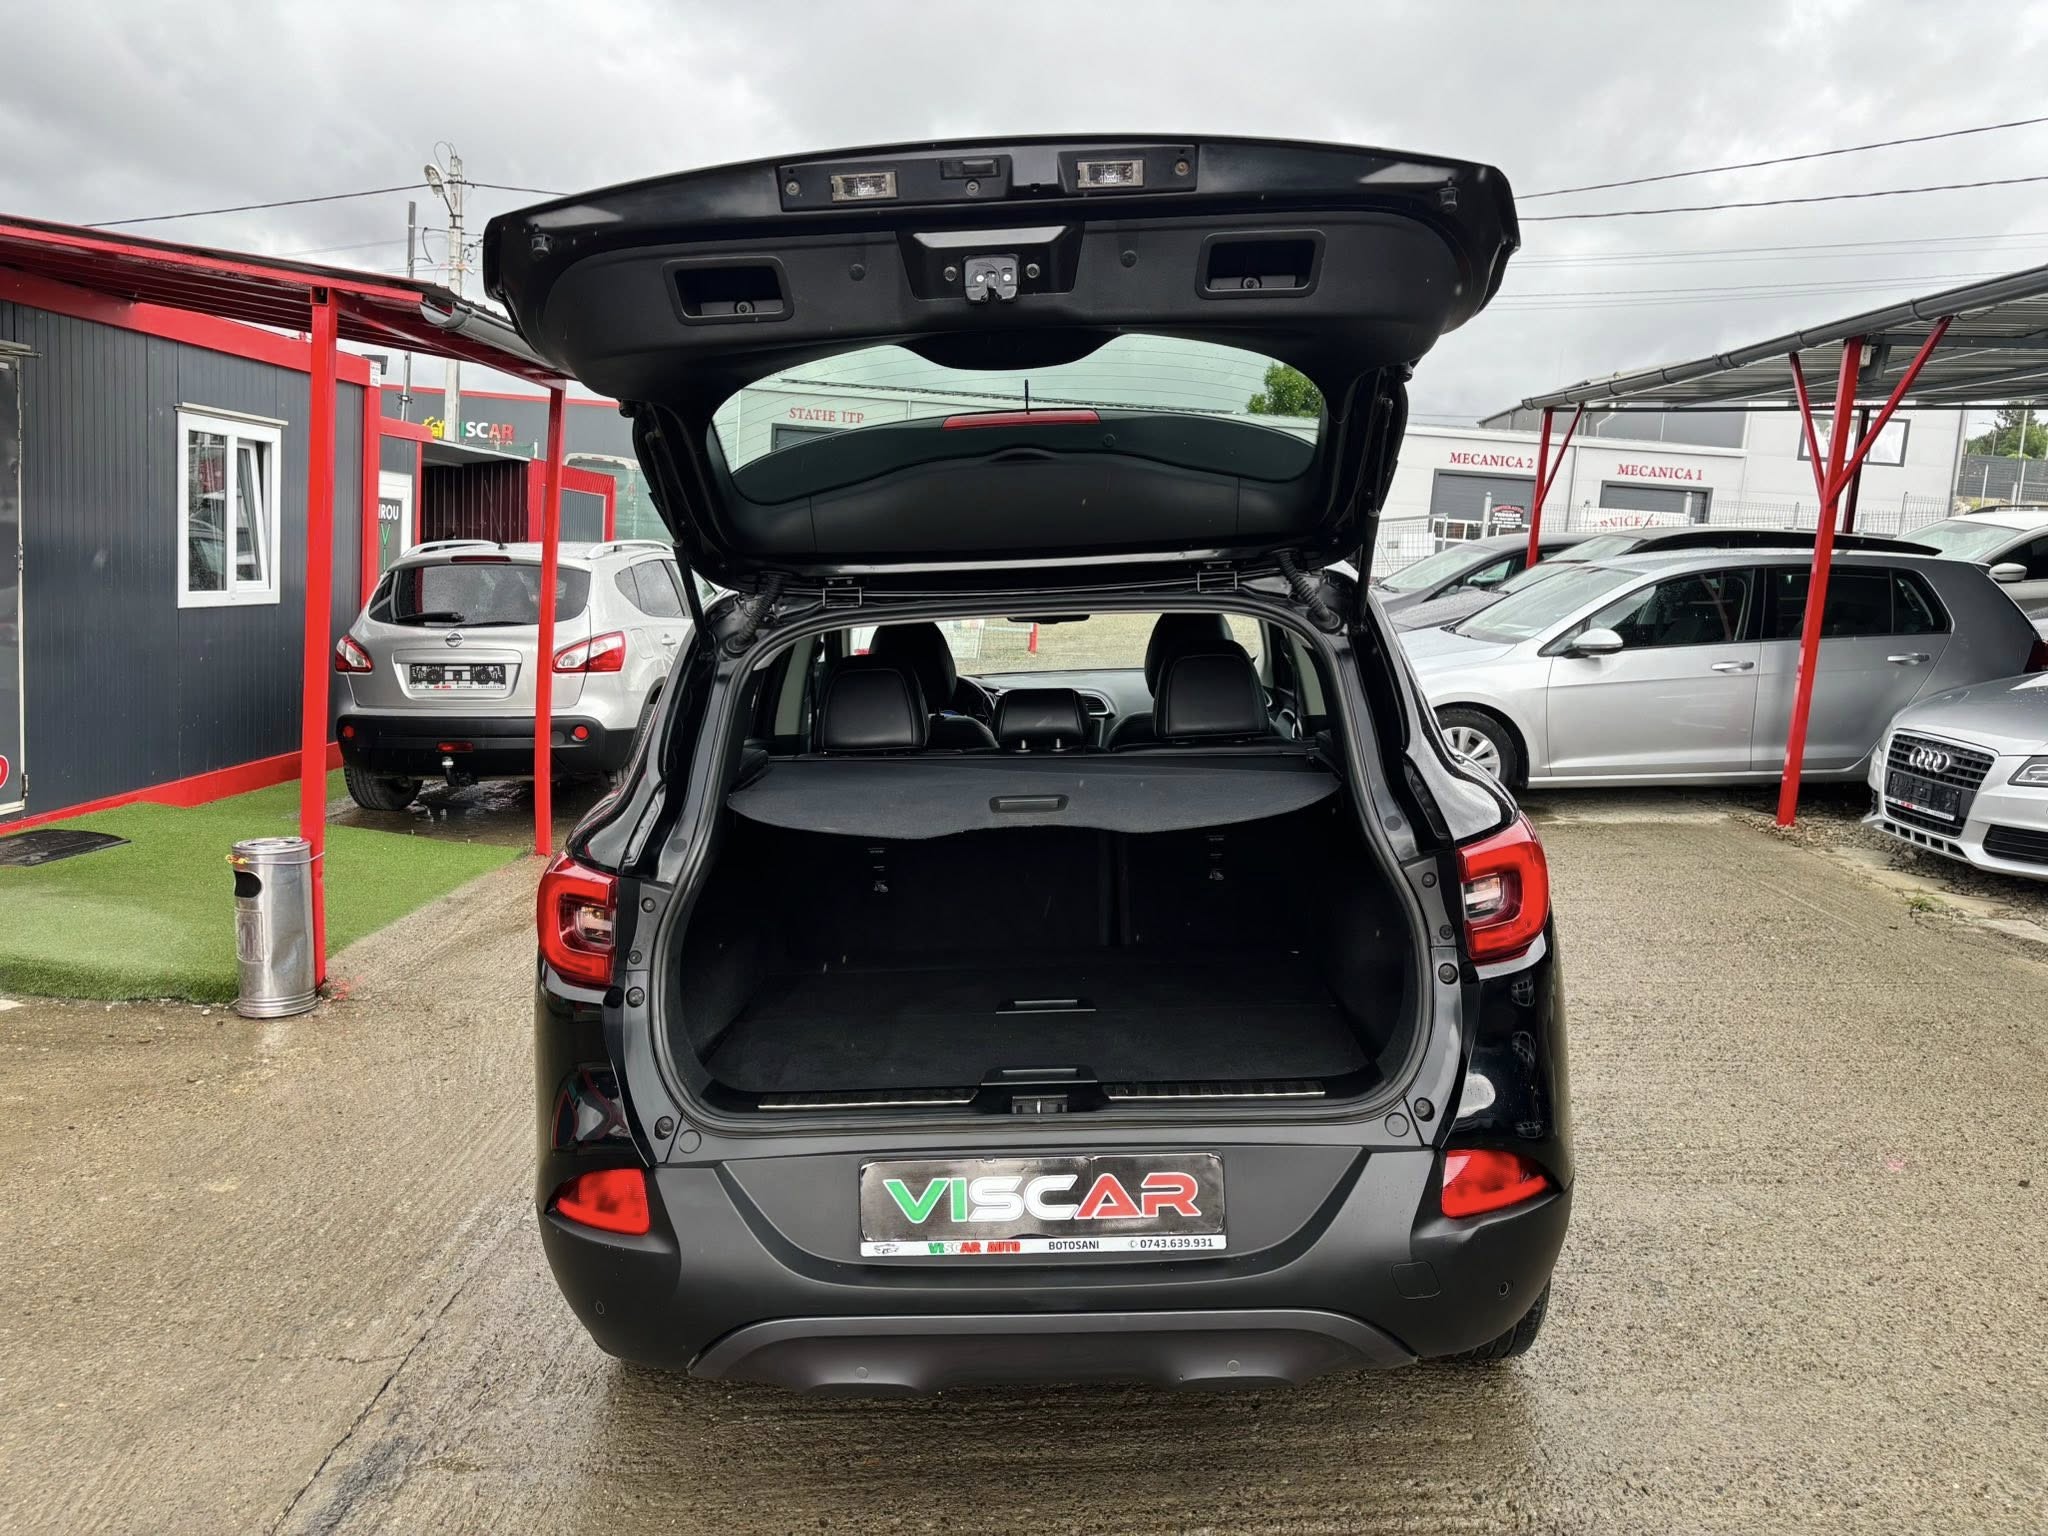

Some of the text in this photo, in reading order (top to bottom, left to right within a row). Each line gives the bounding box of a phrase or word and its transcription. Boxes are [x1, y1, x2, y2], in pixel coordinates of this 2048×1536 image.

[789, 407, 864, 424] STATIE ITP
[460, 420, 514, 439] ISCAR
[1449, 452, 1534, 468] MECANICA 2
[1617, 464, 1703, 480] MECANICA 1
[378, 504, 399, 520] IROU
[883, 1172, 1202, 1223] VISCAR
[928, 1238, 1214, 1253] VISCAR AUTO BOTOSANI 0743.639.931
